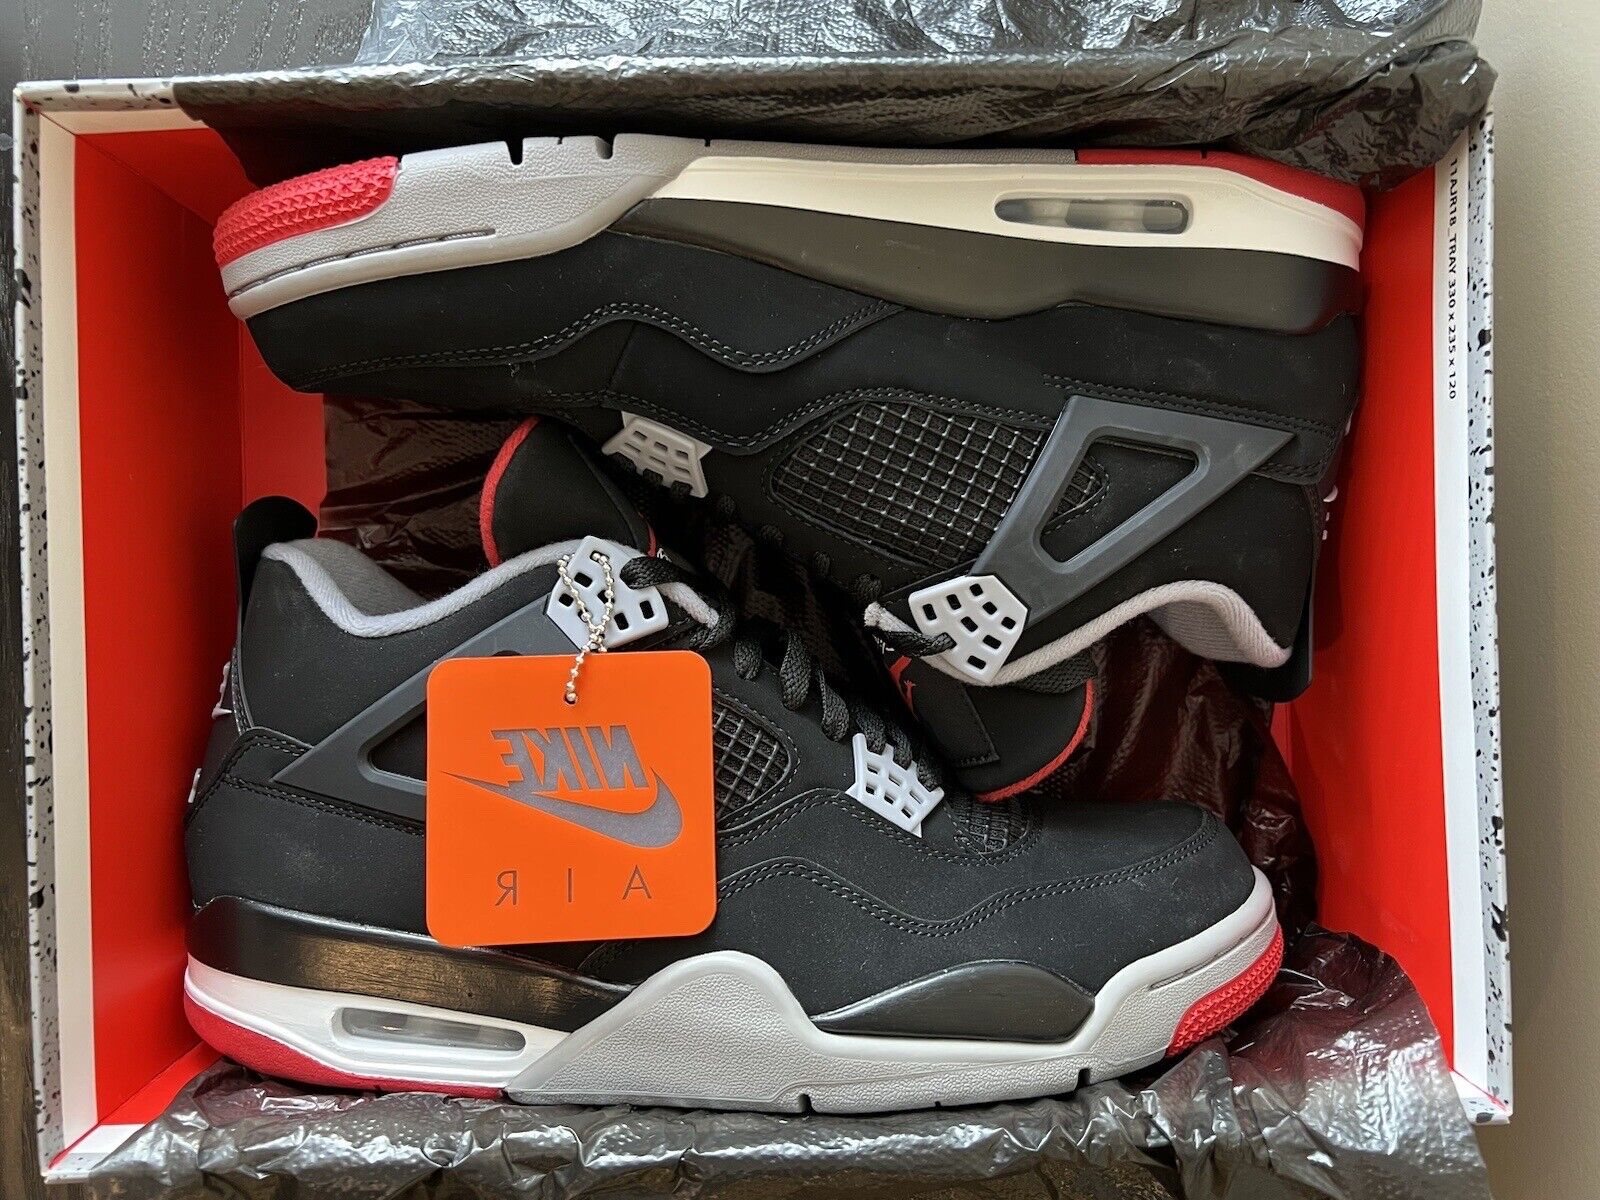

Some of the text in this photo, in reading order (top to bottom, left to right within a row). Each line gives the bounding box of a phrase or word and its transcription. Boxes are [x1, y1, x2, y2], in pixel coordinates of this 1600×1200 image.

[1448, 158, 1458, 274] 11AJR18_TRAY
[1448, 279, 1456, 308] 330
[1448, 312, 1455, 321] x
[1448, 325, 1456, 354] 235
[1448, 358, 1455, 367] x
